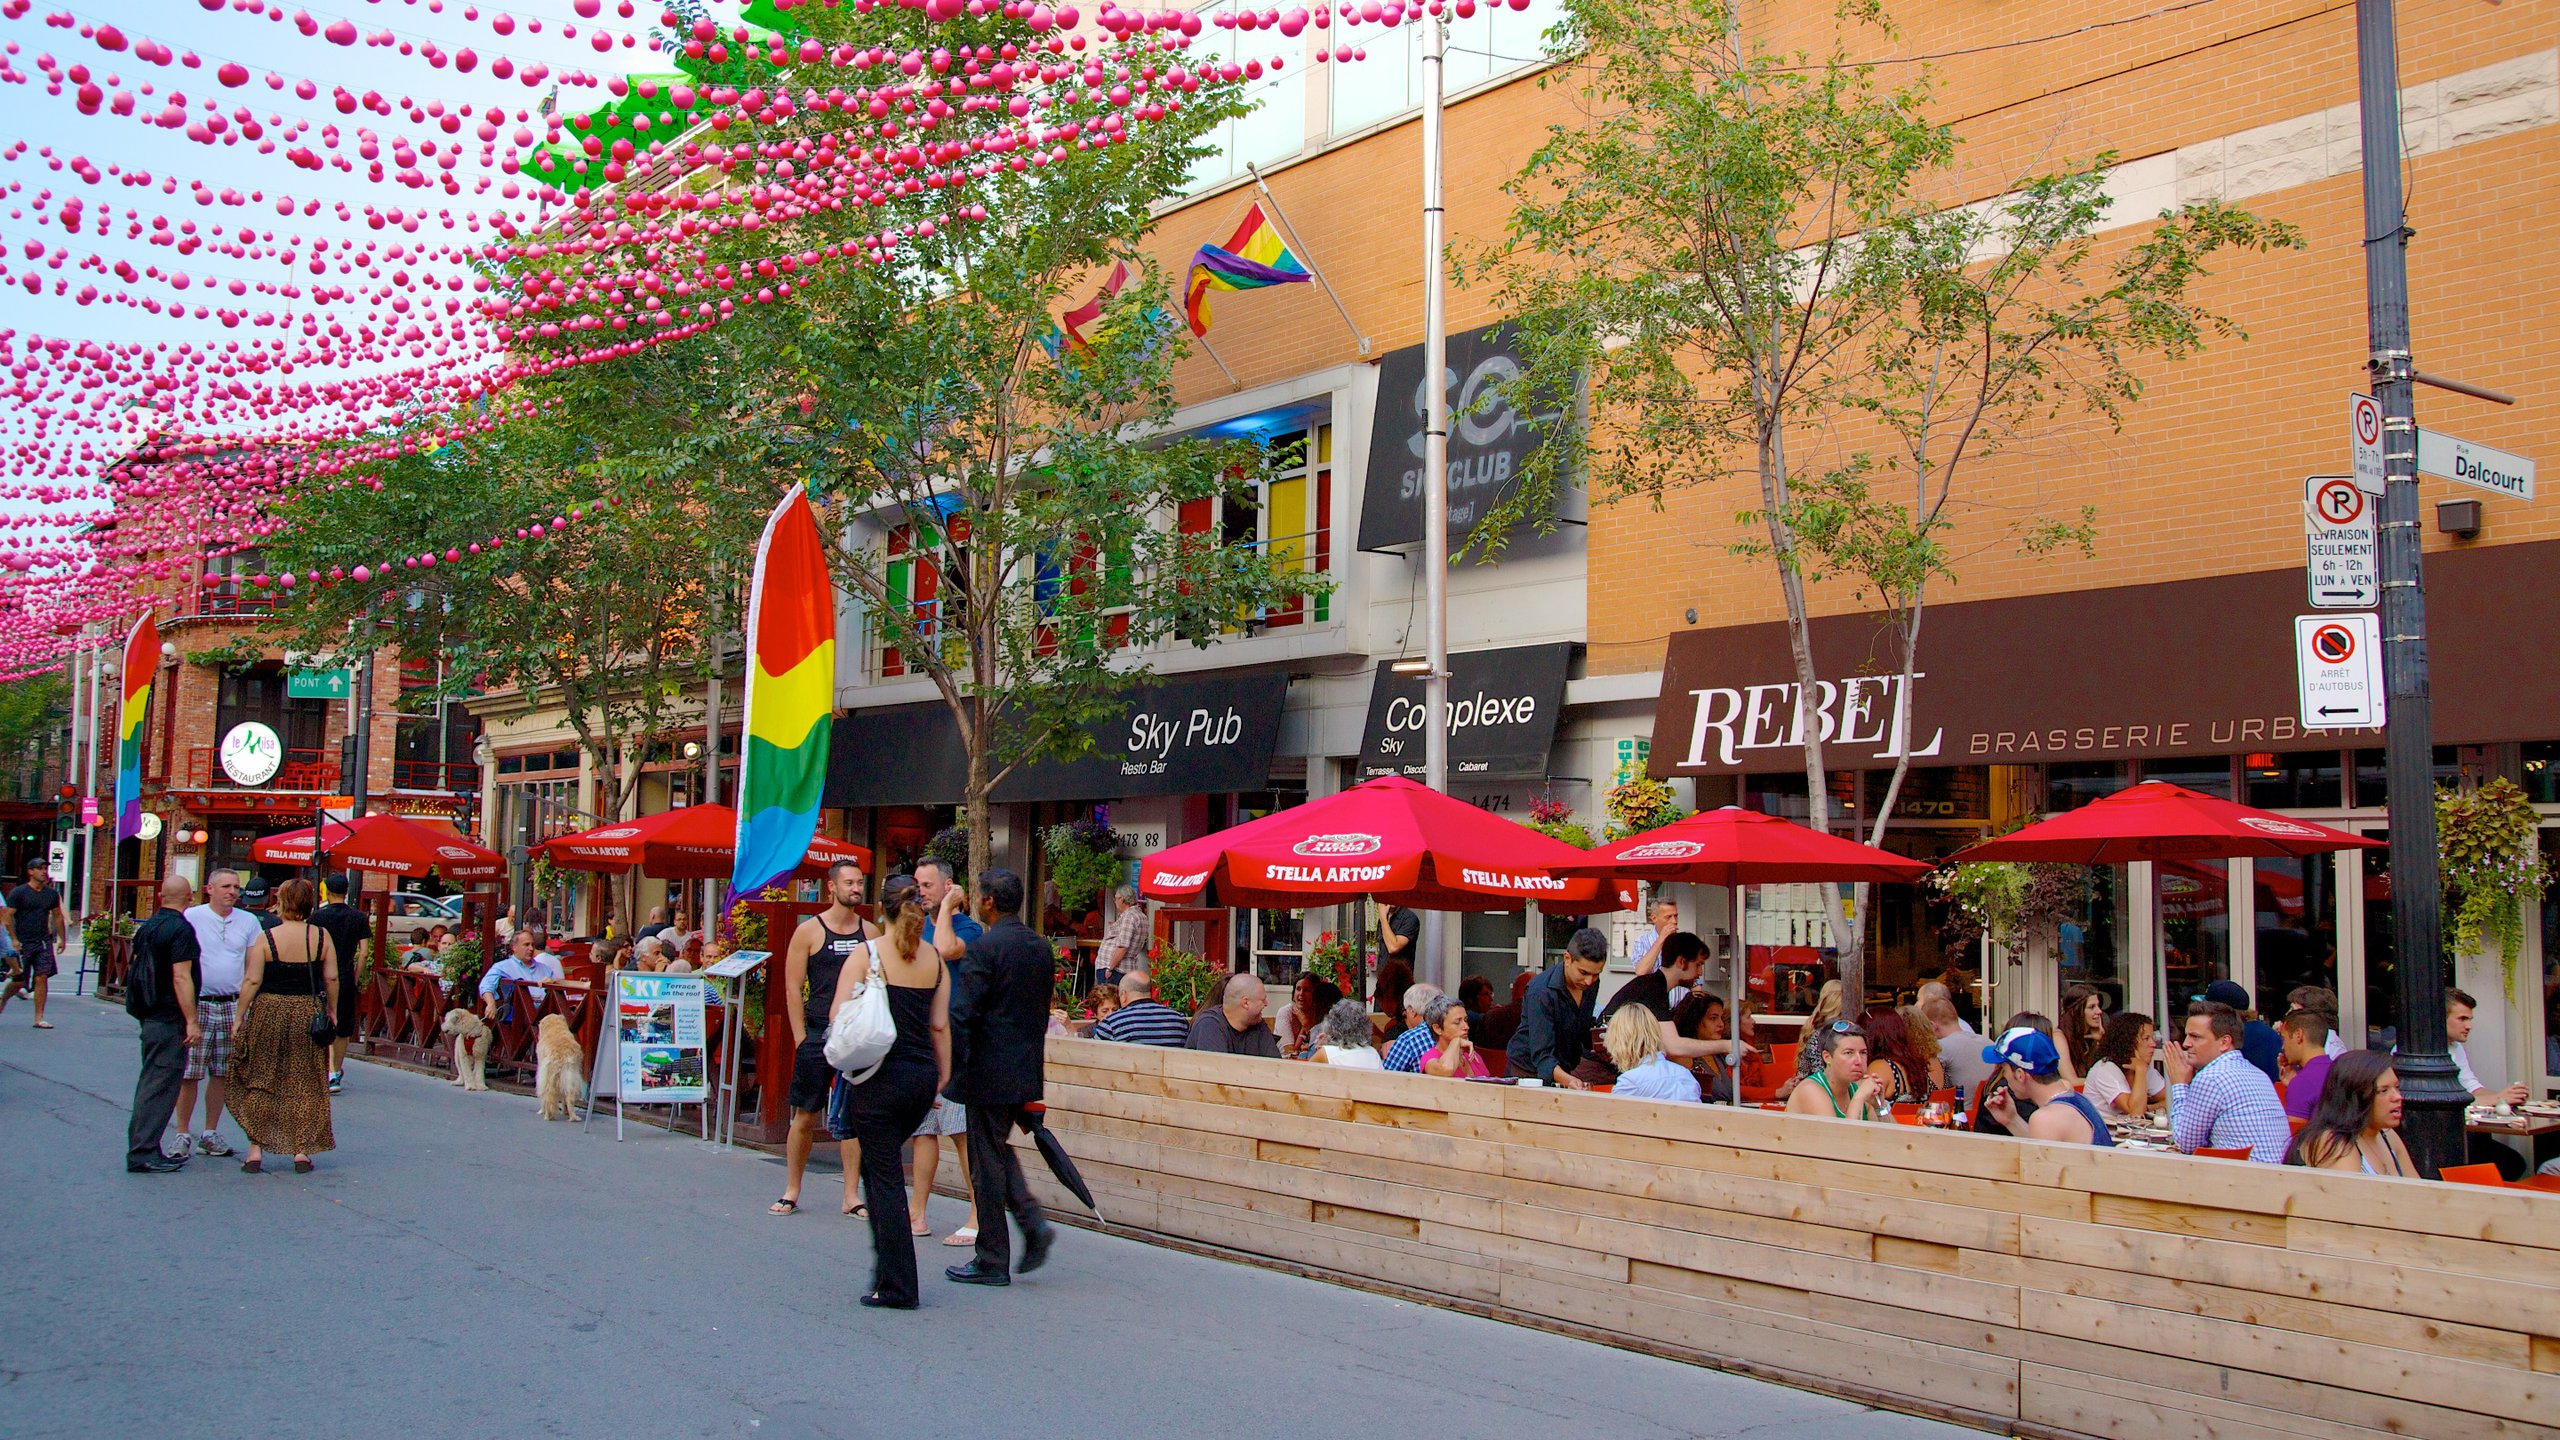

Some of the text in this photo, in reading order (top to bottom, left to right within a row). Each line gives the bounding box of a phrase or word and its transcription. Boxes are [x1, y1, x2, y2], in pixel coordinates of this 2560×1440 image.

[2456, 445, 2469, 454] Rue
[2456, 456, 2524, 493] Dalcourt
[2314, 529, 2369, 540] LIVRAISON
[2311, 544, 2372, 555] SEULEMENT
[2323, 560, 2335, 570] 6h
[2346, 560, 2362, 570] 12h
[2315, 575, 2334, 586] LUN
[2351, 575, 2372, 585] VEN
[2320, 668, 2350, 678] ARRÊT
[294, 678, 319, 687] PONT
[2309, 682, 2364, 691] D'AUTOBUS
[1676, 672, 1943, 767] REBEL
[1127, 706, 1242, 759] Sky Pub
[1969, 723, 2190, 754] BRASSERIE
[1380, 737, 1405, 756] Sky
[225, 759, 276, 783] RESTAURANT
[1120, 760, 1167, 775] Resto Bar
[1365, 766, 1395, 776] Terrasse
[1458, 762, 1488, 771] Cabaret
[1472, 795, 1510, 811] 1474
[1900, 801, 1954, 815] 1470
[1145, 833, 1159, 847] 88
[265, 849, 288, 859] STELLA
[570, 846, 598, 855] STELLA
[675, 845, 713, 854] STELLA
[347, 855, 376, 867] STELLA
[452, 867, 471, 875] STELLA
[1266, 865, 1323, 882] STELLA
[1462, 868, 1512, 888] STELLA
[1152, 871, 1182, 887] STELLA
[620, 977, 662, 997] SKY
[672, 989, 685, 997] the
